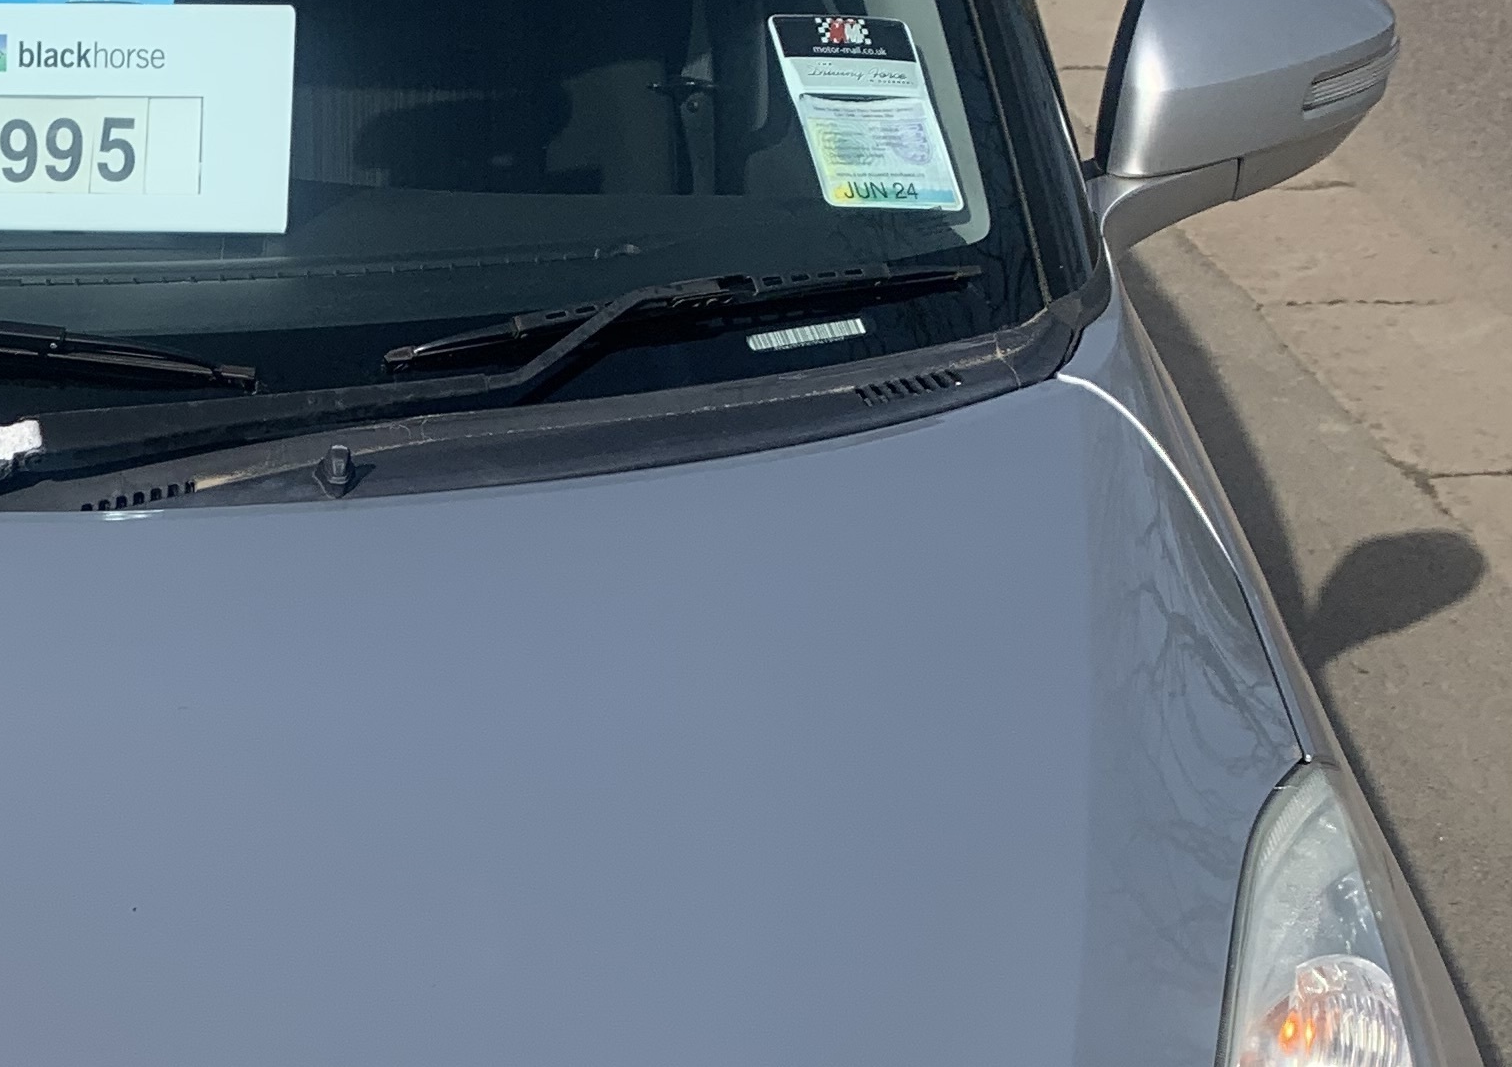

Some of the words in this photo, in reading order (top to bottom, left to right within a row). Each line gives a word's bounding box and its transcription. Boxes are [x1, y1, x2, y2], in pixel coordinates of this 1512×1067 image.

[17, 41, 166, 70] blackhorse
[812, 46, 888, 56] motor-mall.co.uk
[843, 180, 889, 200] JUN
[892, 182, 920, 201] 24
